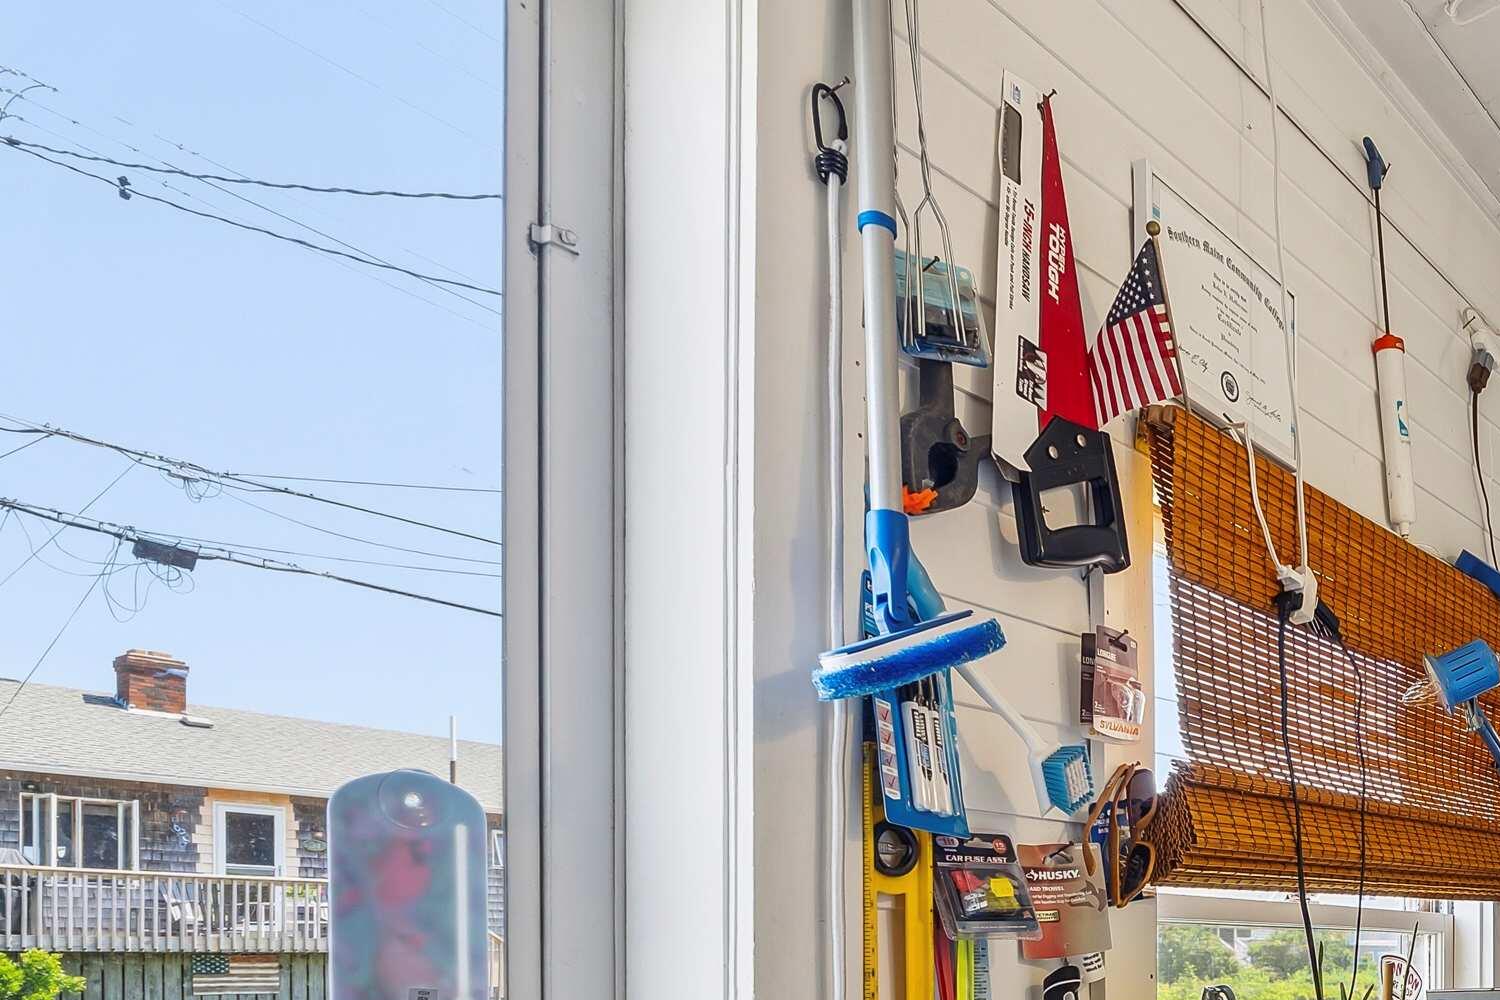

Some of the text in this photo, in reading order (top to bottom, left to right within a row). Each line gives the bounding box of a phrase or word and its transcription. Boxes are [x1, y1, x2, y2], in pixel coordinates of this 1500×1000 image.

[1021, 198, 1035, 303] 15-INCH HANDSAW
[1048, 223, 1060, 301] TOUGH
[1167, 226, 1200, 248] Southern
[1202, 240, 1225, 264] Maine
[1226, 256, 1263, 303] Community
[1100, 720, 1139, 736] SYLVANIA
[945, 854, 1008, 864] CAR FUSE ASST
